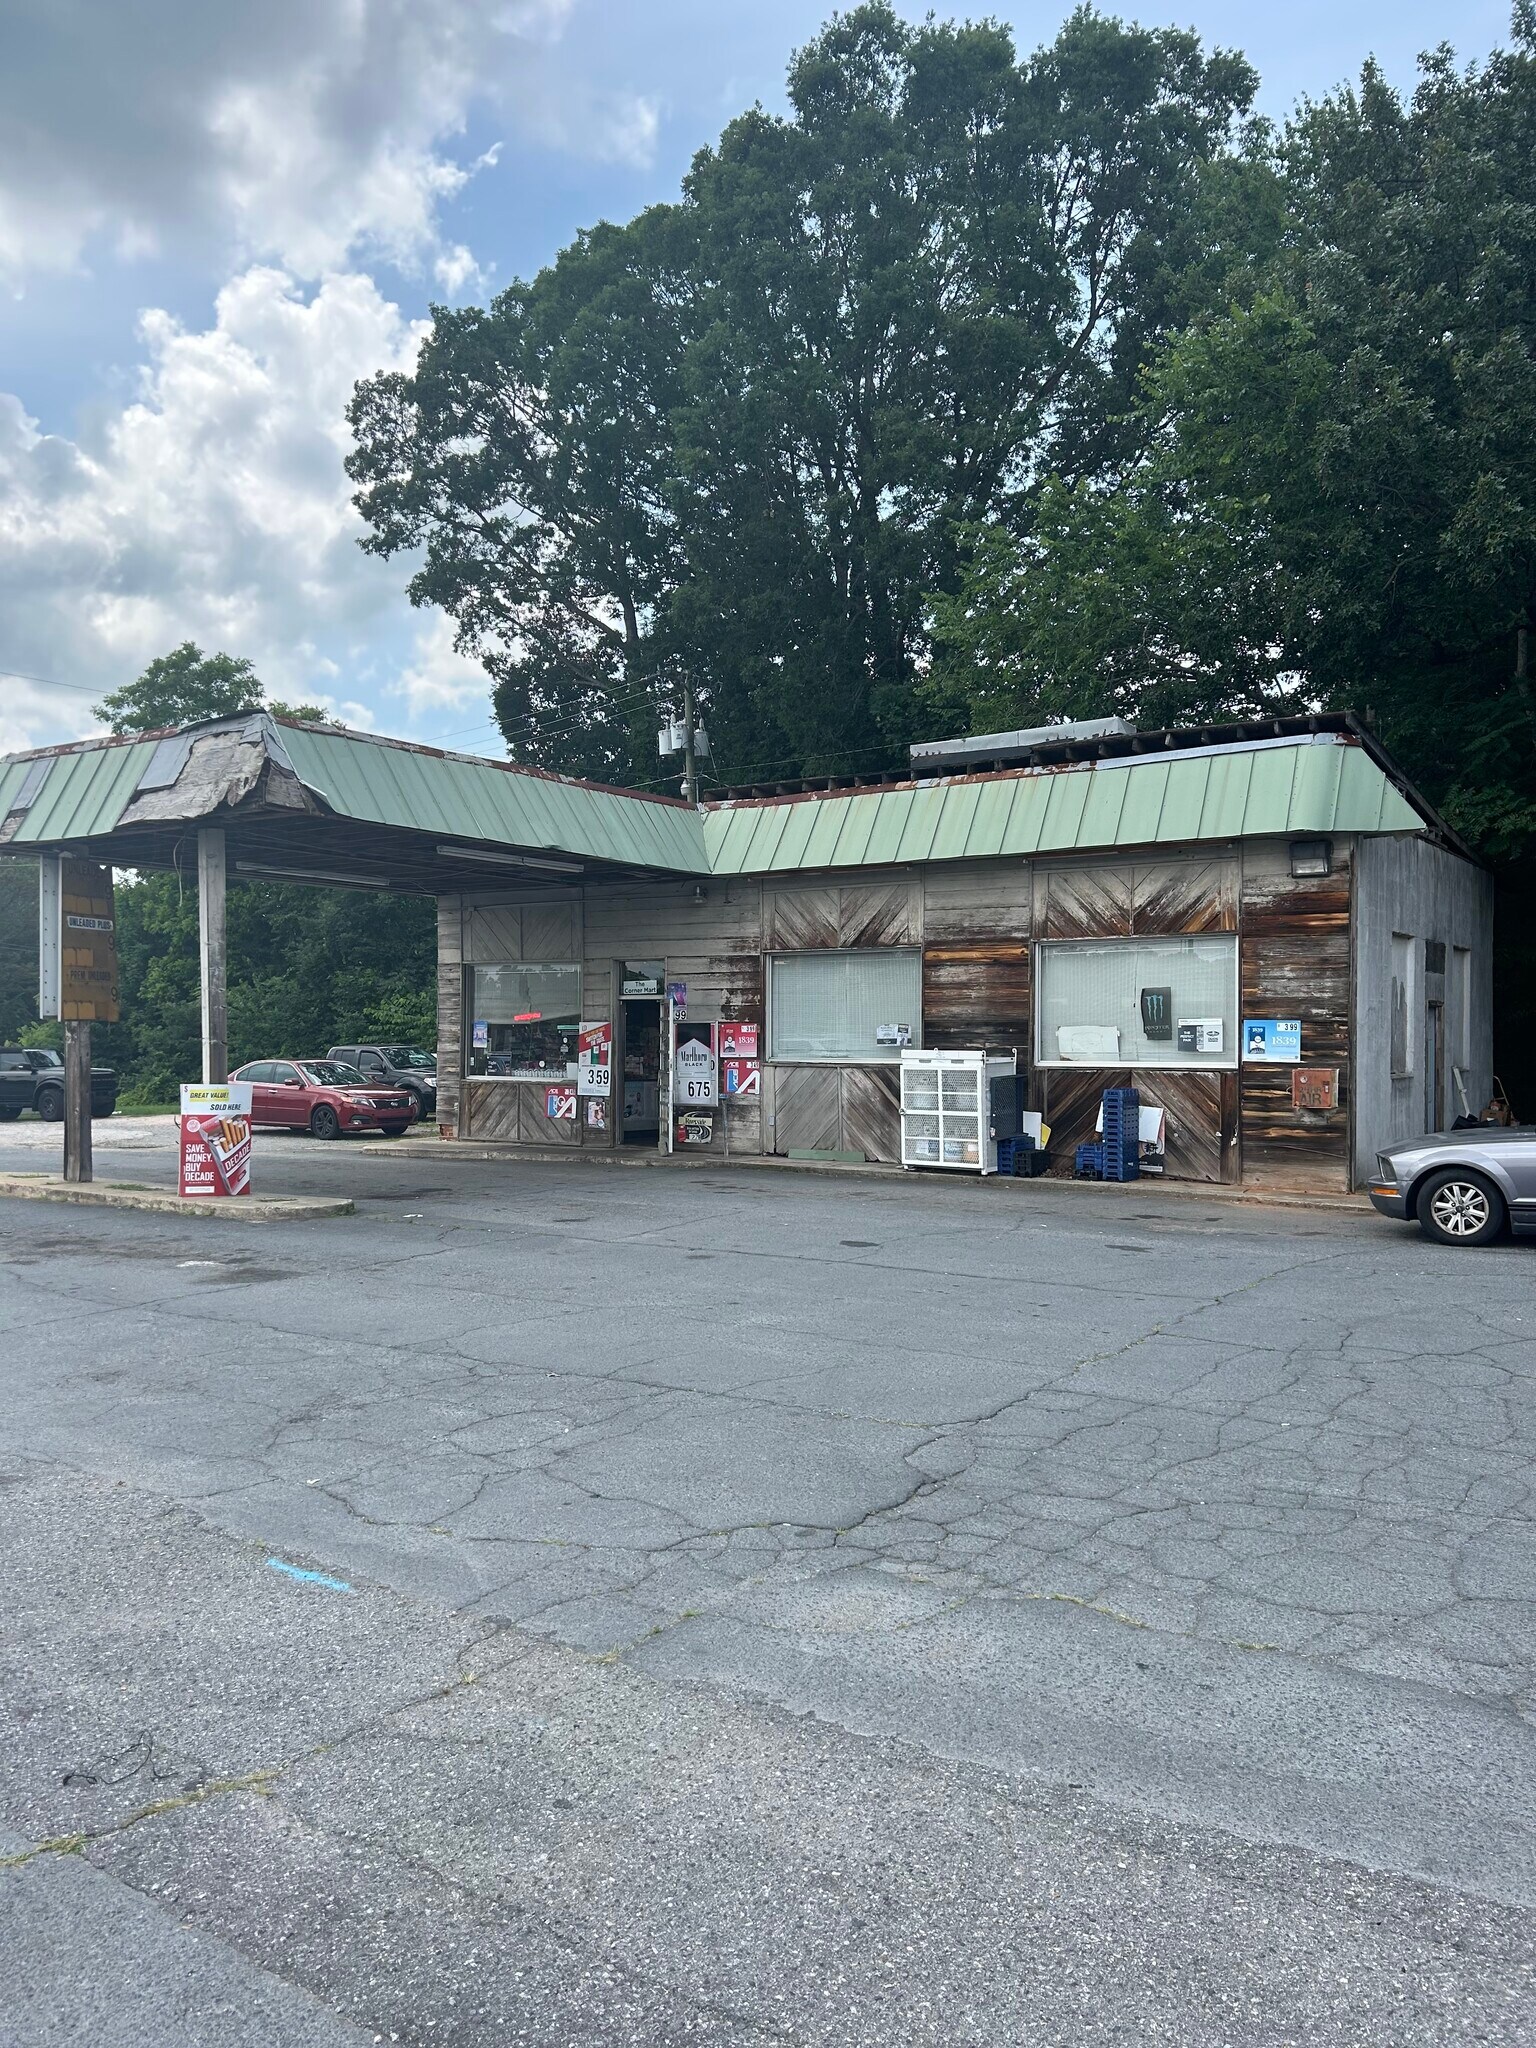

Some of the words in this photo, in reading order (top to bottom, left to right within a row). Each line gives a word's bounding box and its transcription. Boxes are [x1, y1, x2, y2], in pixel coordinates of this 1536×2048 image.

[69, 917, 96, 928] UNLEADED
[97, 920, 111, 930] PLUS
[108, 935, 115, 951] 9
[111, 986, 117, 1002] 9
[1271, 1036, 1297, 1045] 1839
[681, 1046, 708, 1061] Marlboro
[588, 1069, 609, 1085] 359
[688, 1081, 710, 1097] 675
[1301, 1093, 1321, 1104] AIR
[185, 1144, 205, 1153] SAVE
[185, 1153, 213, 1162] MONEY.
[225, 1142, 250, 1171] DECADE
[185, 1163, 201, 1171] BUY
[185, 1172, 215, 1181] DECADE
